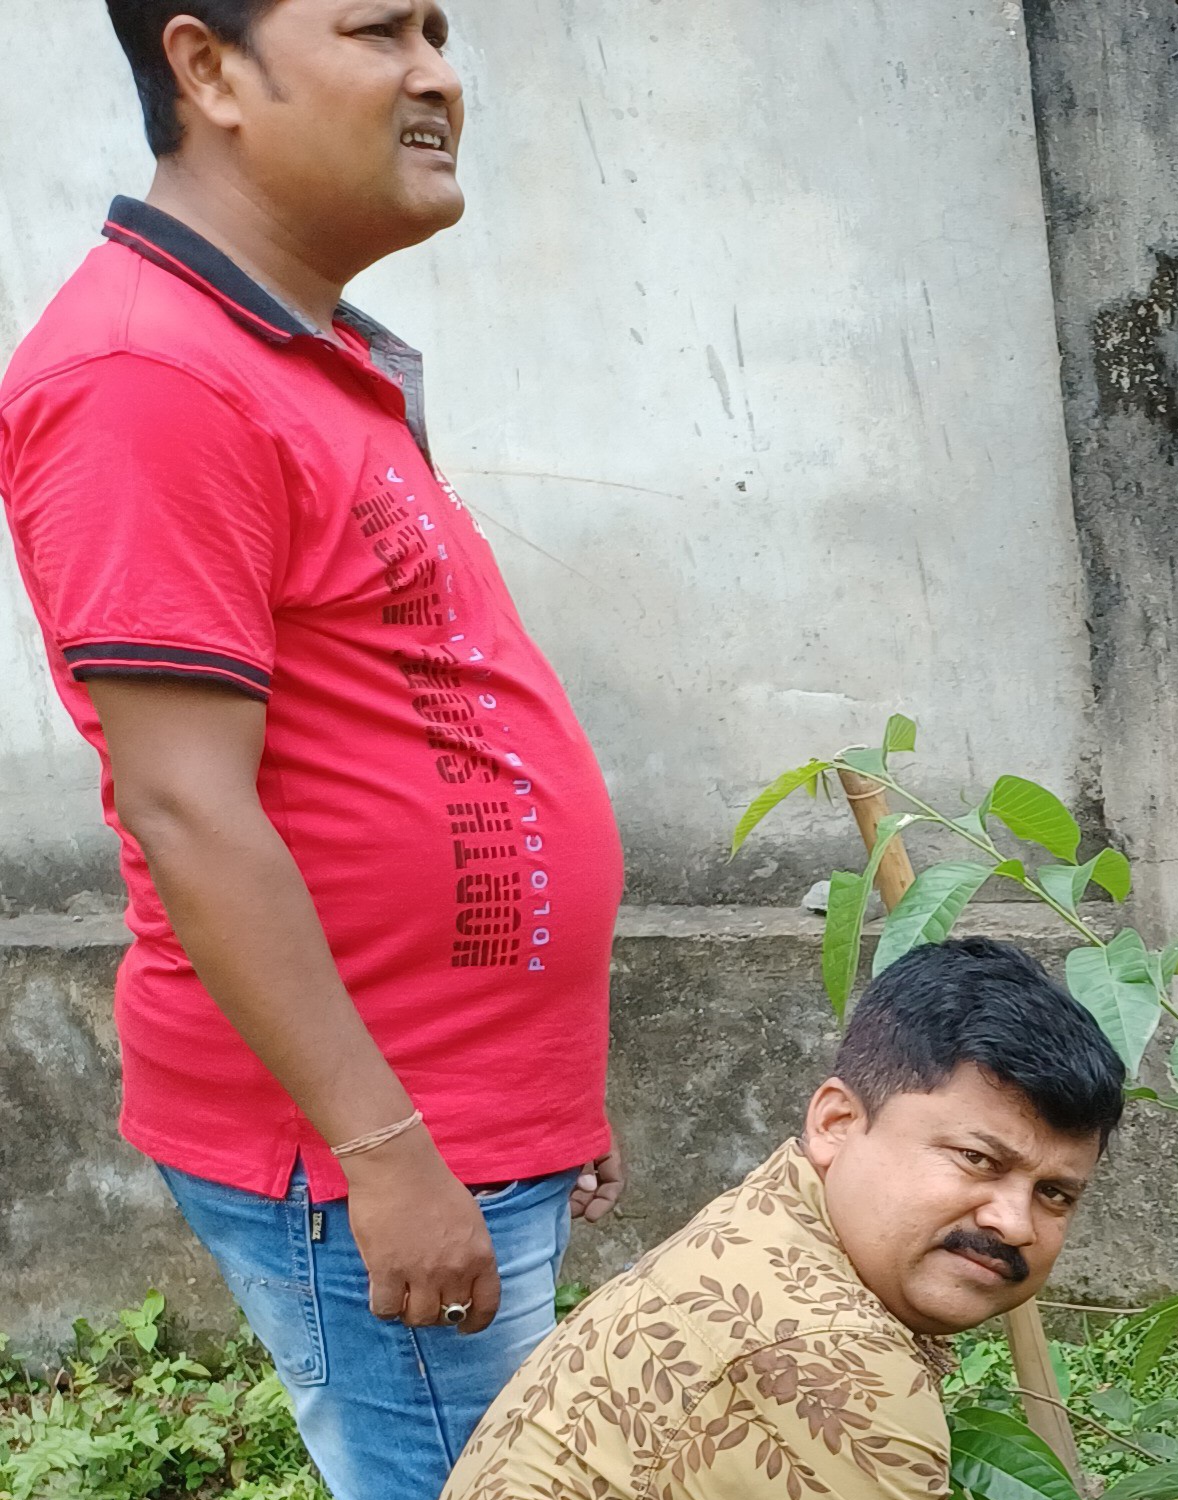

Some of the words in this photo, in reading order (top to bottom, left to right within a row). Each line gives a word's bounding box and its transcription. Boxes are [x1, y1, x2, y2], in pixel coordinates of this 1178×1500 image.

[386, 466, 497, 710] CLIFRNIA
[505, 752, 543, 852] CLUB
[446, 802, 522, 968] NORTH
[528, 868, 551, 972] POLO
